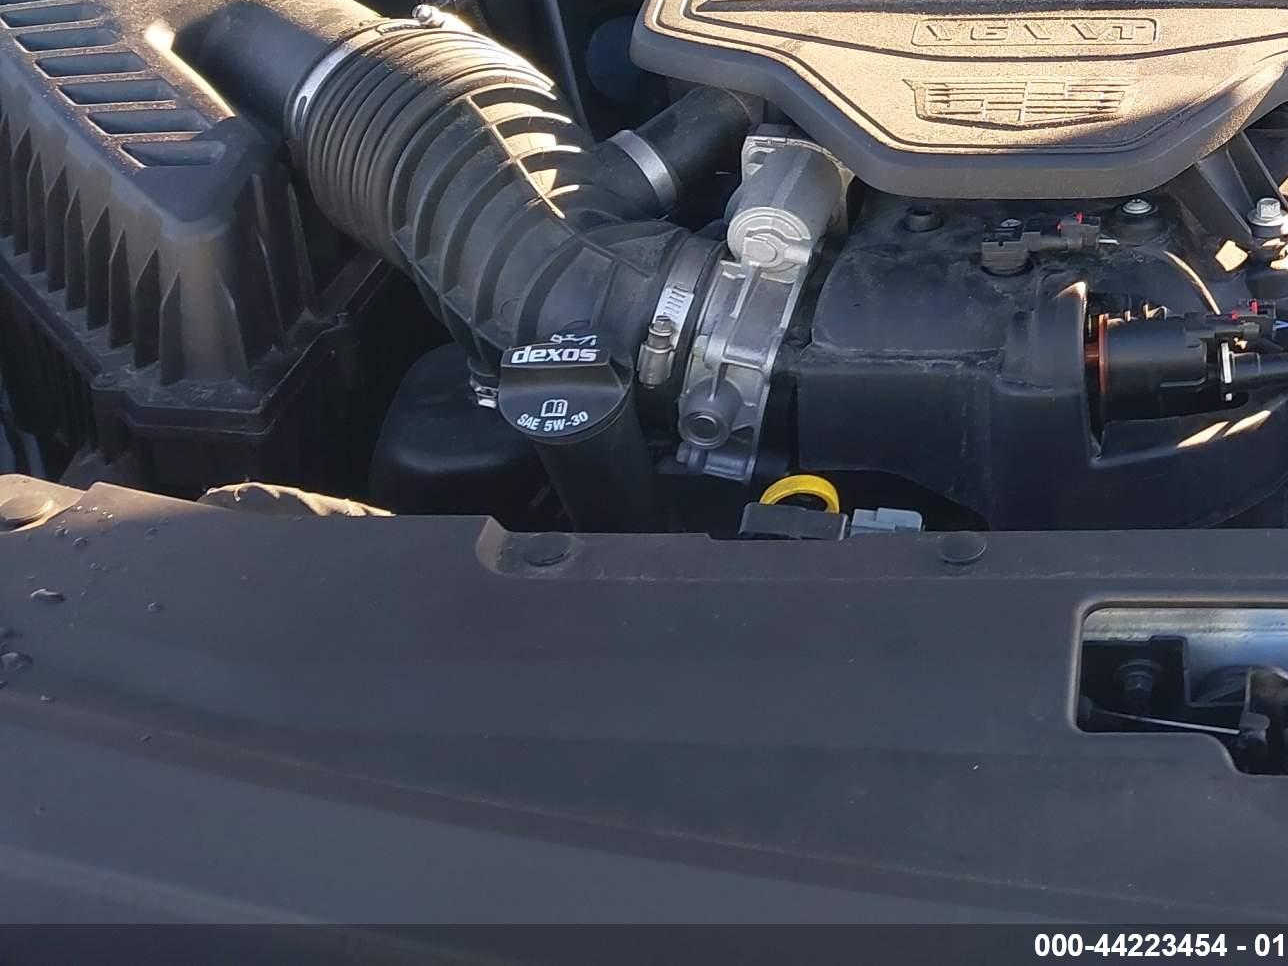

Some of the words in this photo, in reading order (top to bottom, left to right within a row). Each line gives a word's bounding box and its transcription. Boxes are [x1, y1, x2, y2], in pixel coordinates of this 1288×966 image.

[511, 345, 600, 364] dexos
[516, 413, 541, 431] SAE
[543, 410, 589, 432] 5W-30
